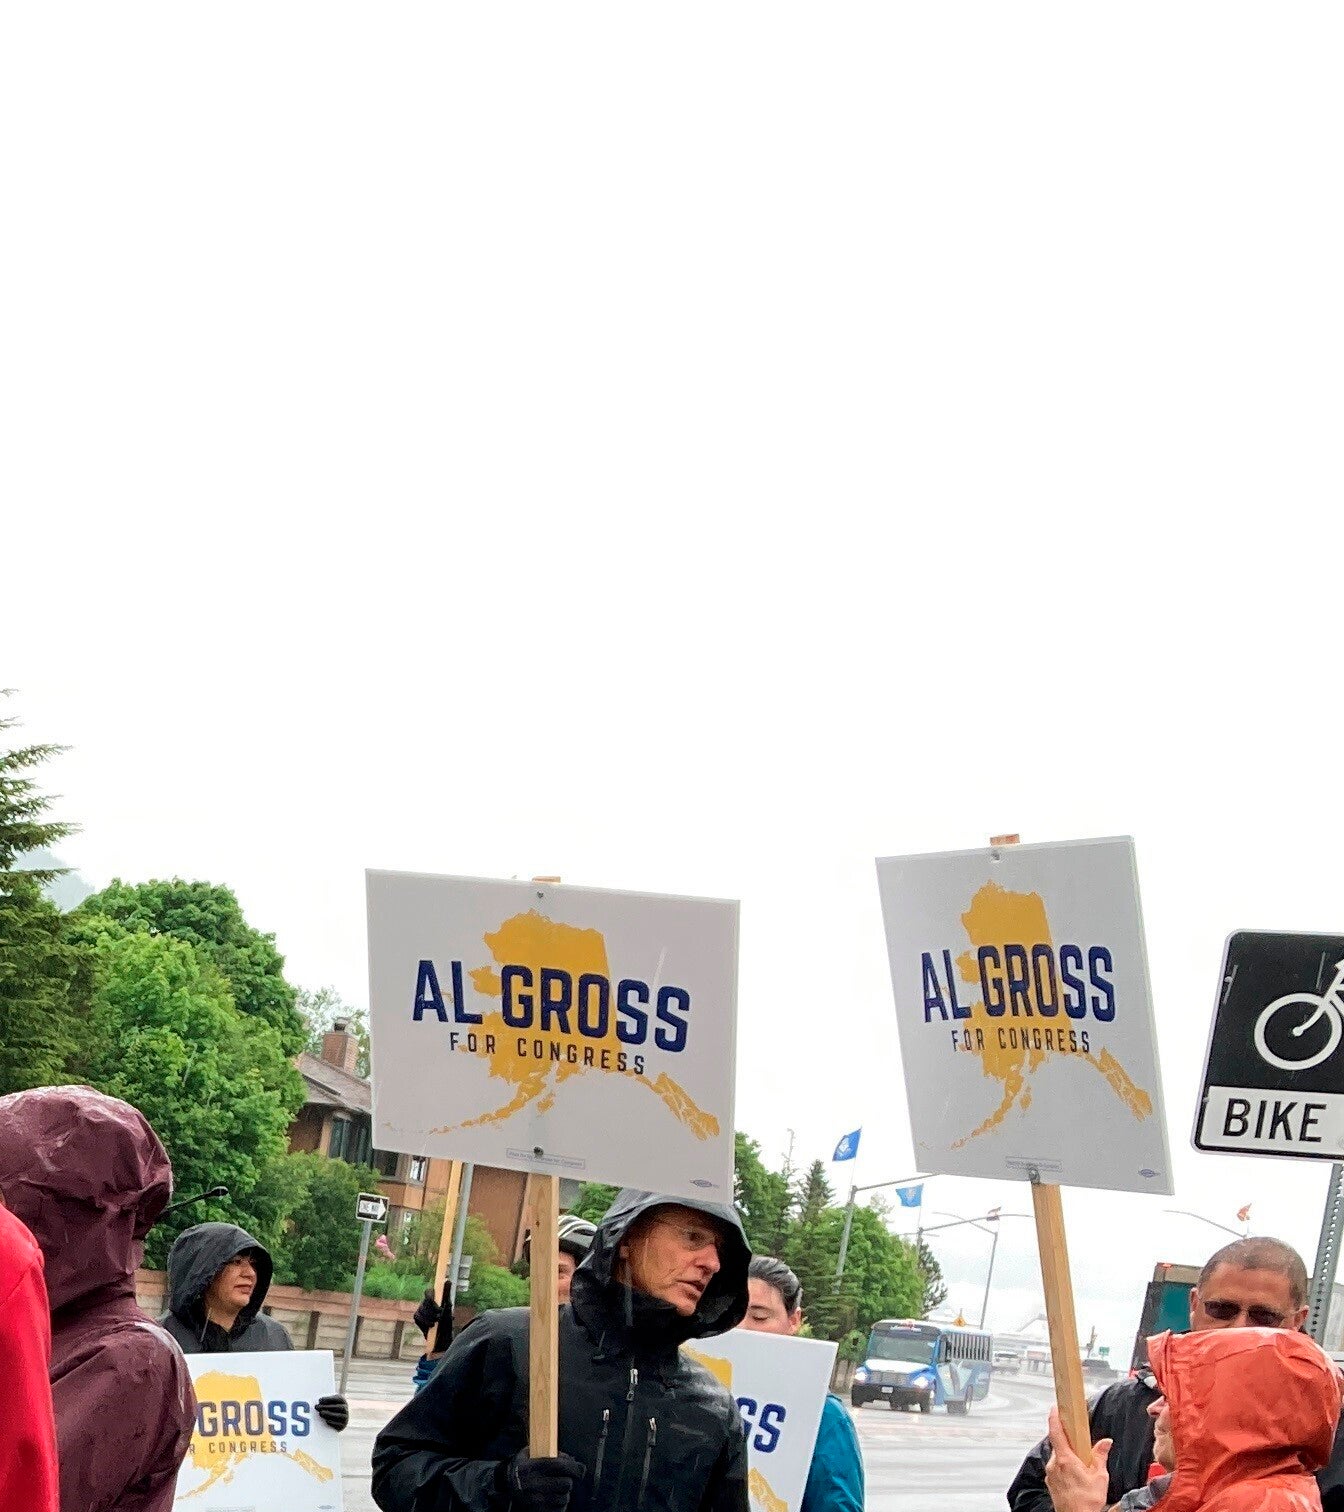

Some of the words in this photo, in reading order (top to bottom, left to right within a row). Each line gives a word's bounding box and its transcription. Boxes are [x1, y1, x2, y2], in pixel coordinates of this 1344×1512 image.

[921, 949, 972, 1023] AL
[977, 944, 1116, 1023] GROSS
[412, 959, 483, 1025] AL
[501, 964, 690, 1053] GROSS
[450, 1031, 496, 1054] FOR
[517, 1037, 645, 1075] CONGRESS
[951, 1029, 984, 1052] FOR
[998, 1029, 1090, 1054] CONGRESS
[1222, 1098, 1327, 1143] BIKE
[197, 1400, 311, 1437] GROSS
[209, 1441, 288, 1454] CONGRESS
